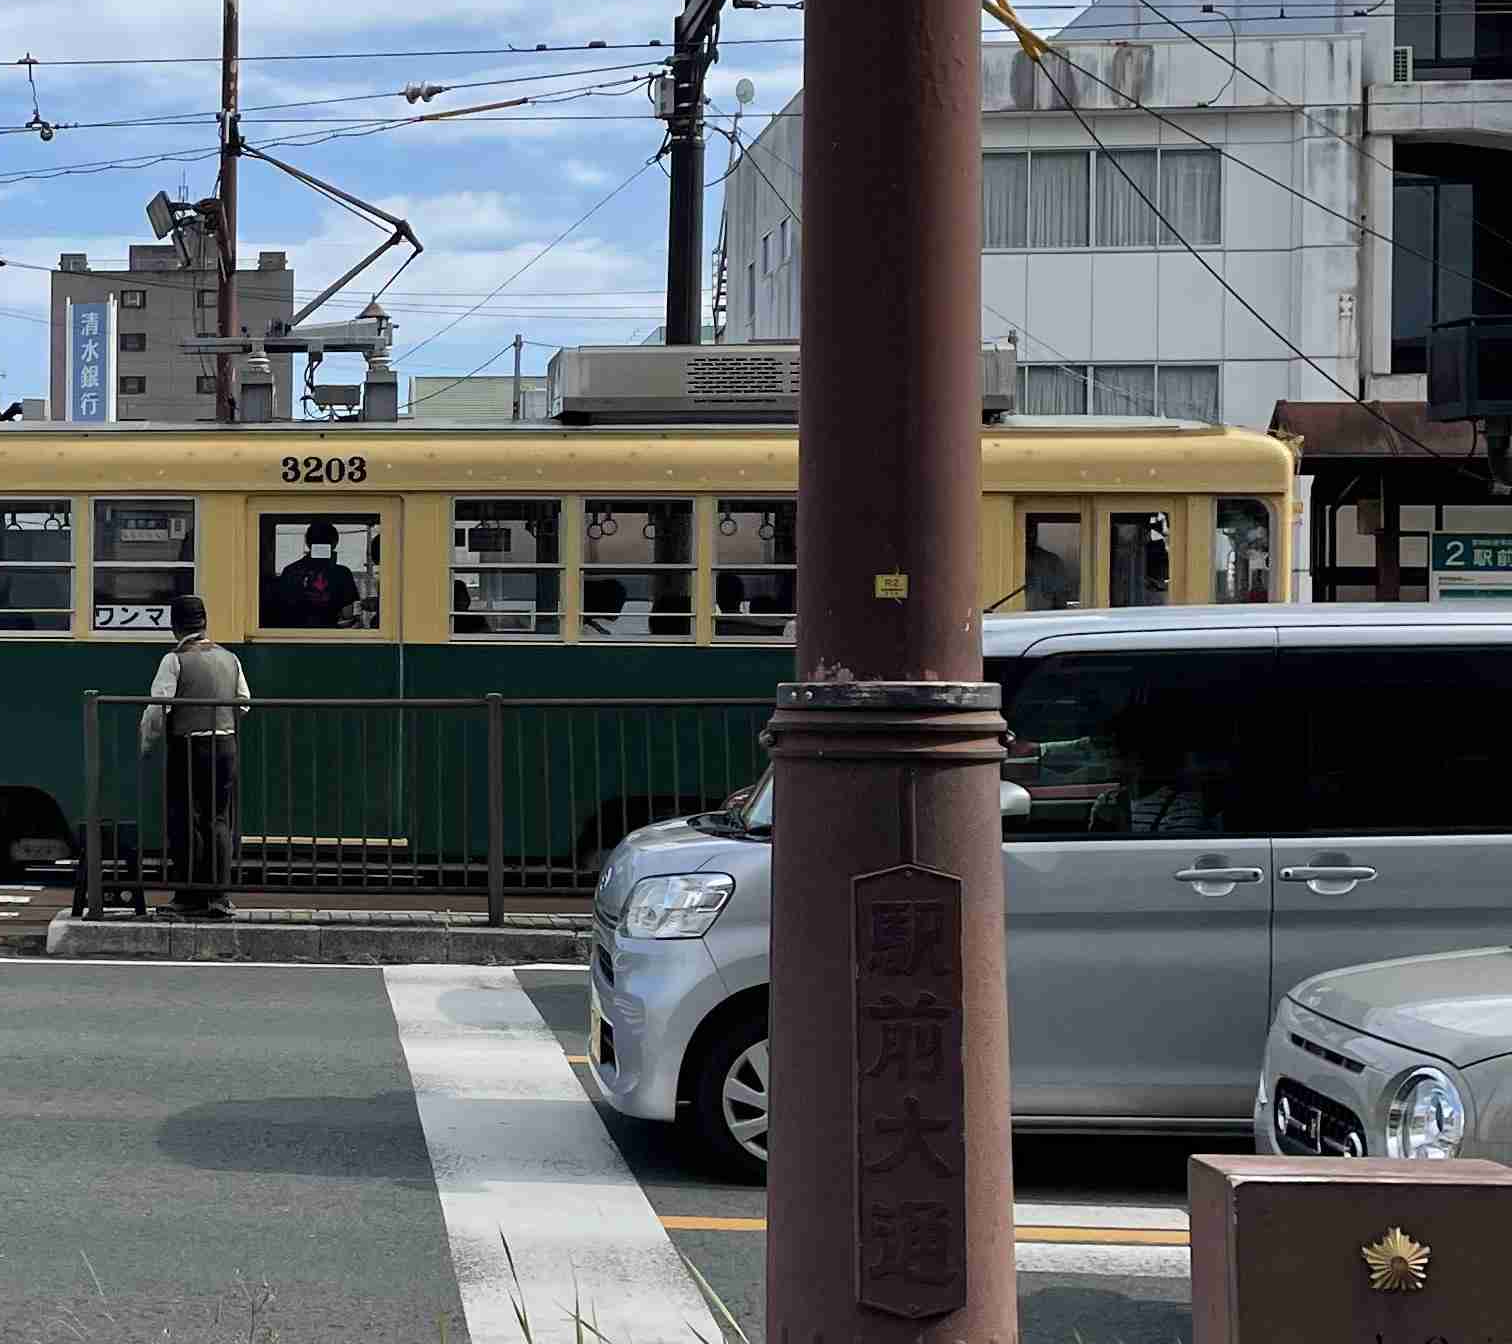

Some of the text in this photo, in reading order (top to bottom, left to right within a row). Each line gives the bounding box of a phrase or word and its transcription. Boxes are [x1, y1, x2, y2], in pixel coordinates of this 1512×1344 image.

[80, 311, 99, 416] 清水銀行
[282, 456, 367, 483] 3203
[1445, 541, 1465, 566] 2
[859, 898, 958, 1288] 駅前大通
